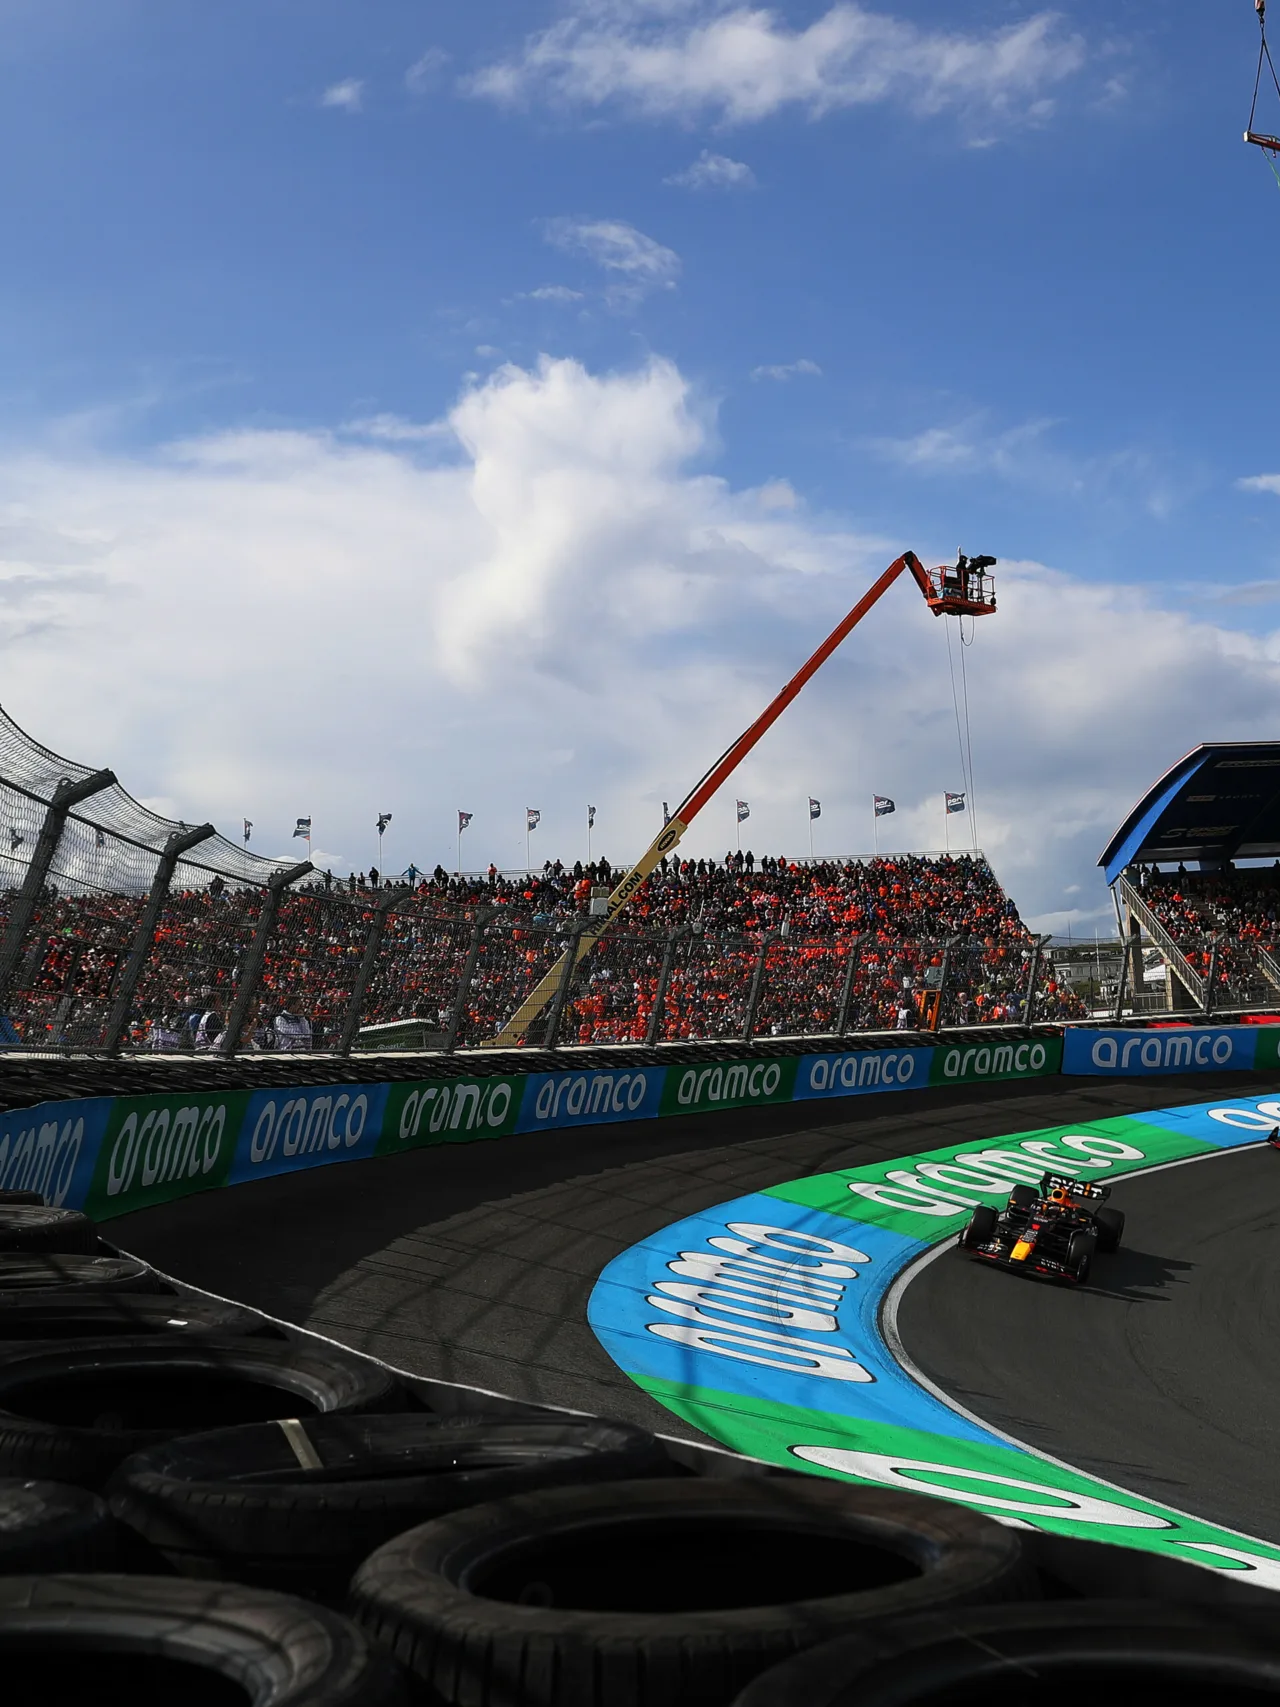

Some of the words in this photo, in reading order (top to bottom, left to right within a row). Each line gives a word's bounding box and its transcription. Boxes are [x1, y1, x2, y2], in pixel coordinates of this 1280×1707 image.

[810, 1054, 915, 1089] aramco
[943, 1043, 1046, 1077] aramco
[1091, 1034, 1233, 1068] aramco
[536, 1073, 647, 1119] aramco
[678, 1063, 781, 1105] aramco
[251, 1093, 367, 1163] aramco
[399, 1083, 512, 1138] aramco
[107, 1104, 226, 1195] aramco
[847, 1135, 1146, 1217] aramco
[647, 1222, 875, 1384] aramco
